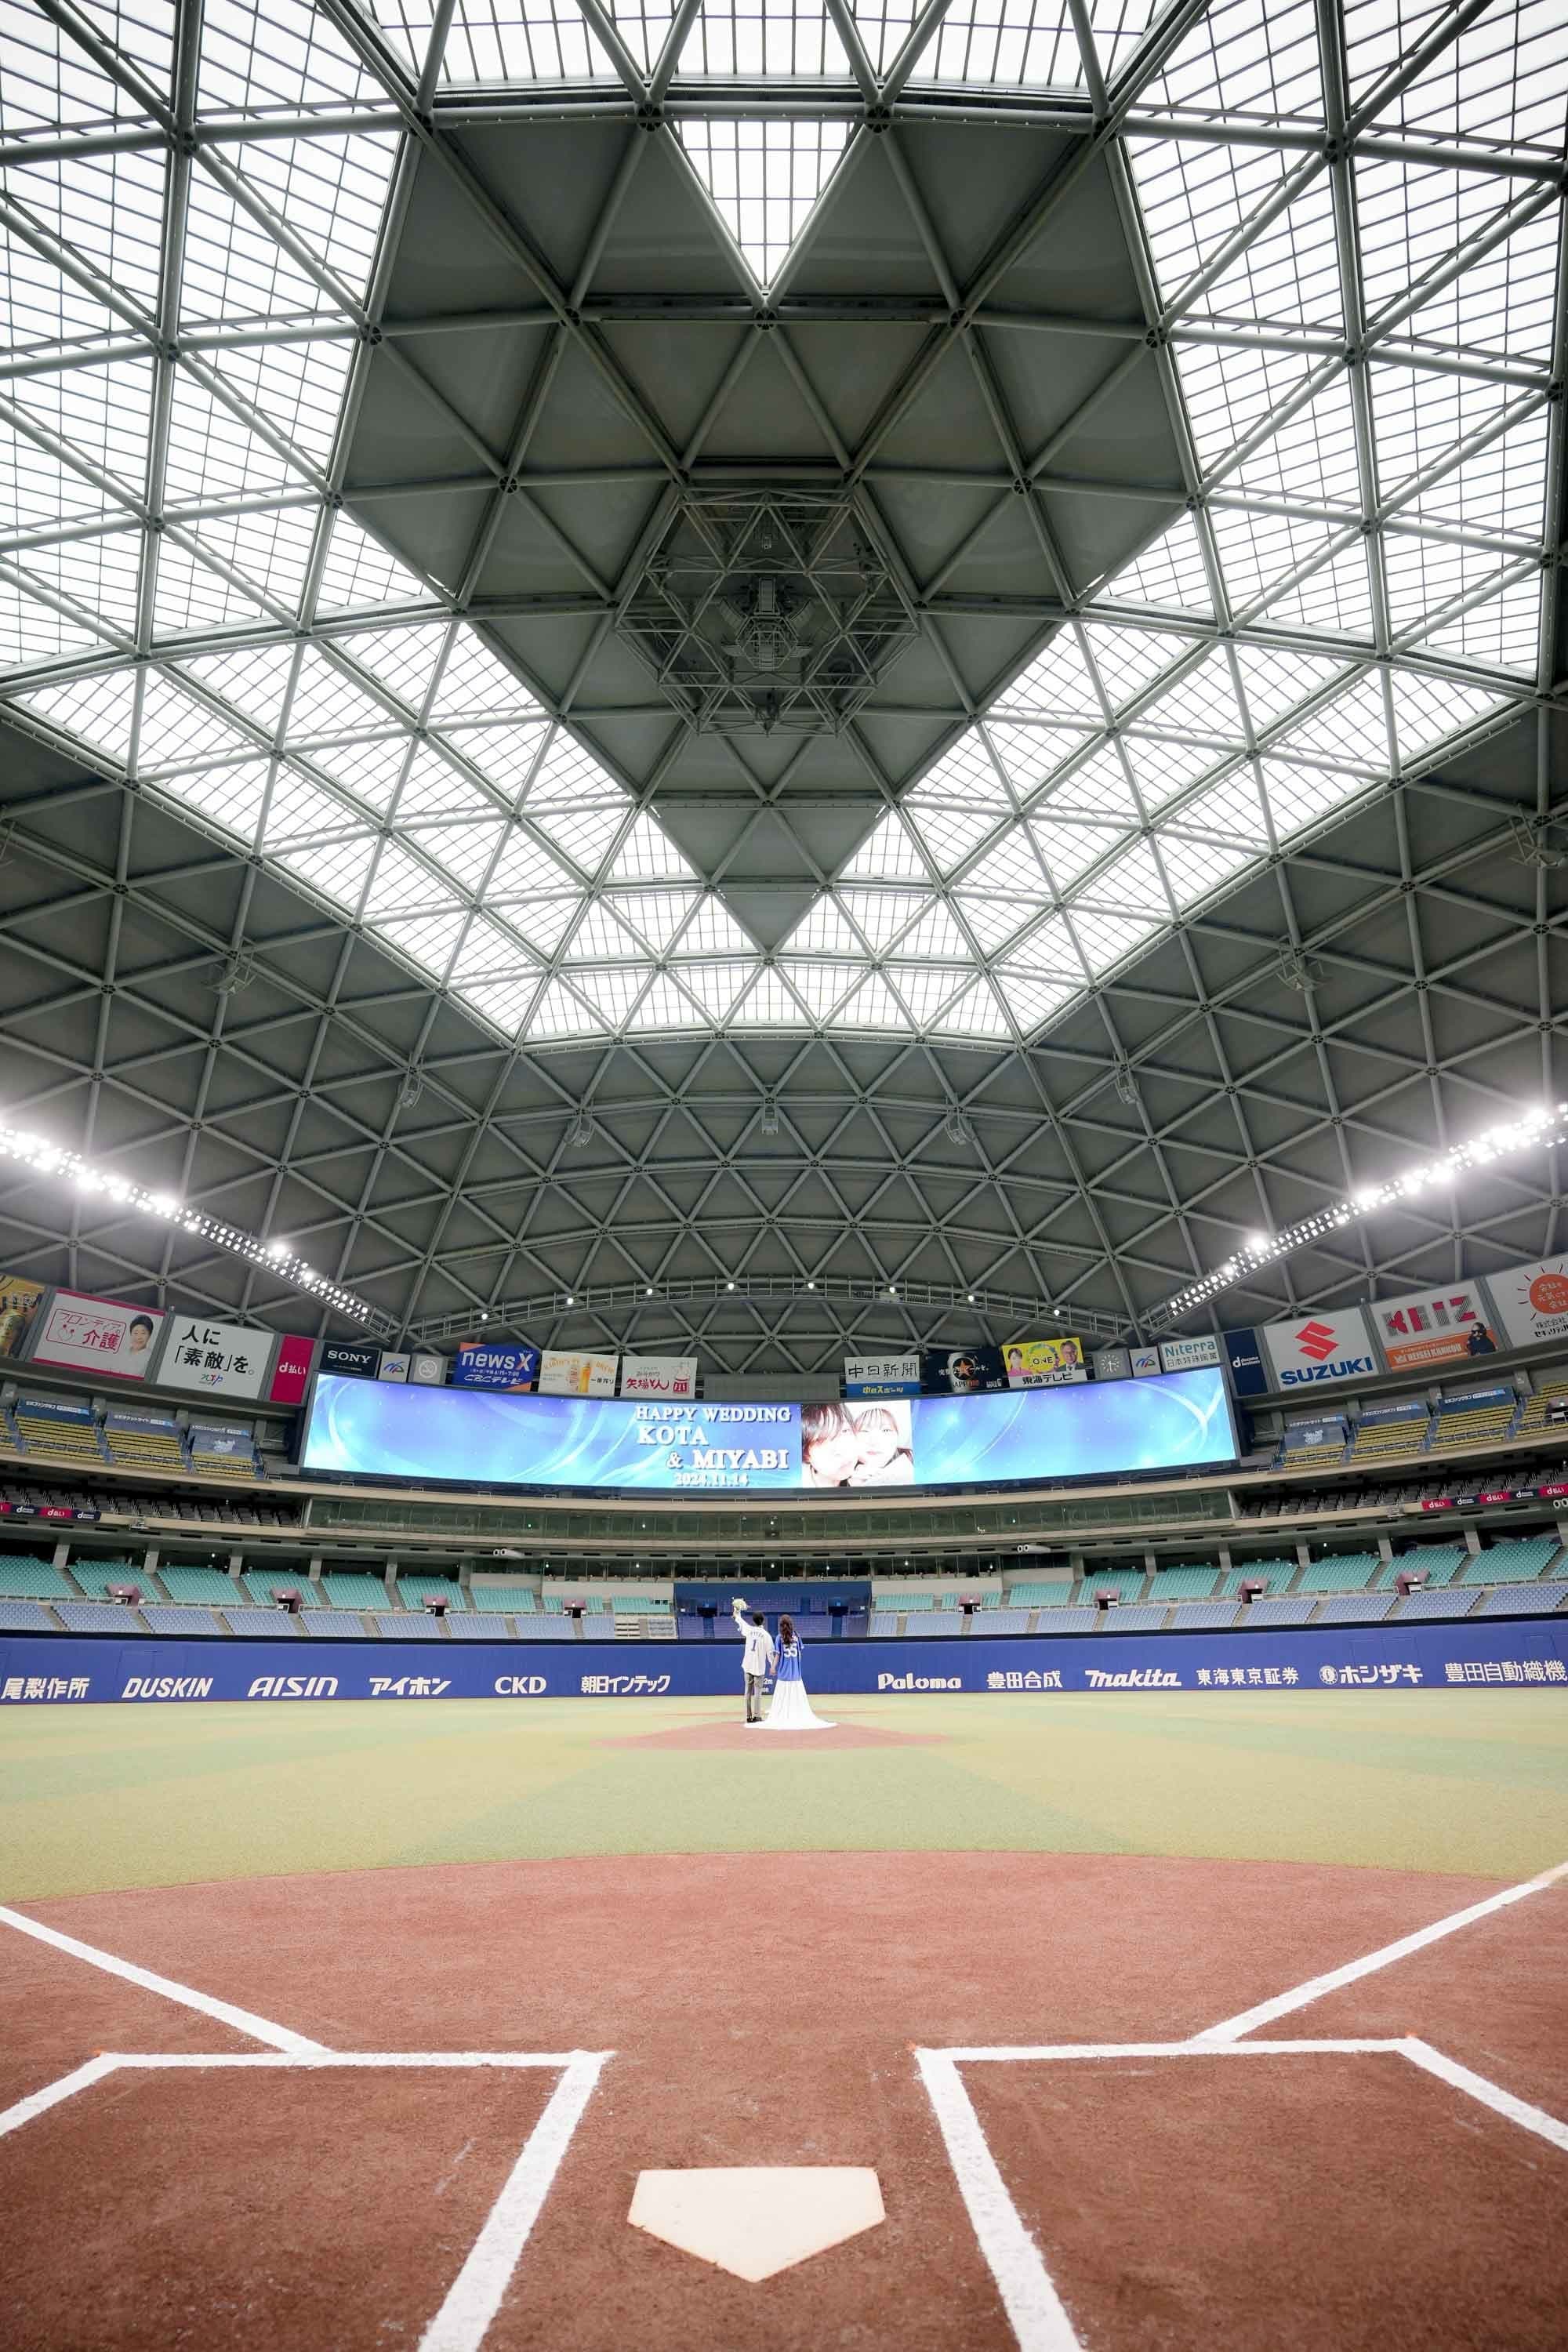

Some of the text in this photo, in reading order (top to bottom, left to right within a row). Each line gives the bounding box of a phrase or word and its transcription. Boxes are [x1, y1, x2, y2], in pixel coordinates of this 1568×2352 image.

[82, 1330, 120, 1351] 介護
[182, 1325, 220, 1345] 人に
[328, 1350, 372, 1364] SONY
[1165, 1341, 1215, 1357] Niterra
[848, 1363, 917, 1378] 中日新聞
[1022, 1373, 1073, 1385] 東海テレビ
[1280, 1357, 1373, 1385] SUZUKI
[636, 1406, 791, 1423] HAPPY WEDDING
[637, 1425, 710, 1446] KOTA
[667, 1449, 789, 1470] & MIYABI
[751, 1639, 757, 1652] 1
[783, 1643, 797, 1658] 55
[986, 1671, 1062, 1689] 豊田合成
[1196, 1667, 1299, 1686] 東海東京証券
[1339, 1664, 1423, 1684] ホシザキ
[1445, 1660, 1568, 1682] 豊田自動織機
[122, 1677, 213, 1698] DUSKIN
[248, 1677, 338, 1697] AISIN
[369, 1677, 452, 1695] アイホン
[495, 1676, 546, 1694] CKD
[581, 1675, 670, 1693] 朝日インテック
[877, 1673, 961, 1690] Paloma
